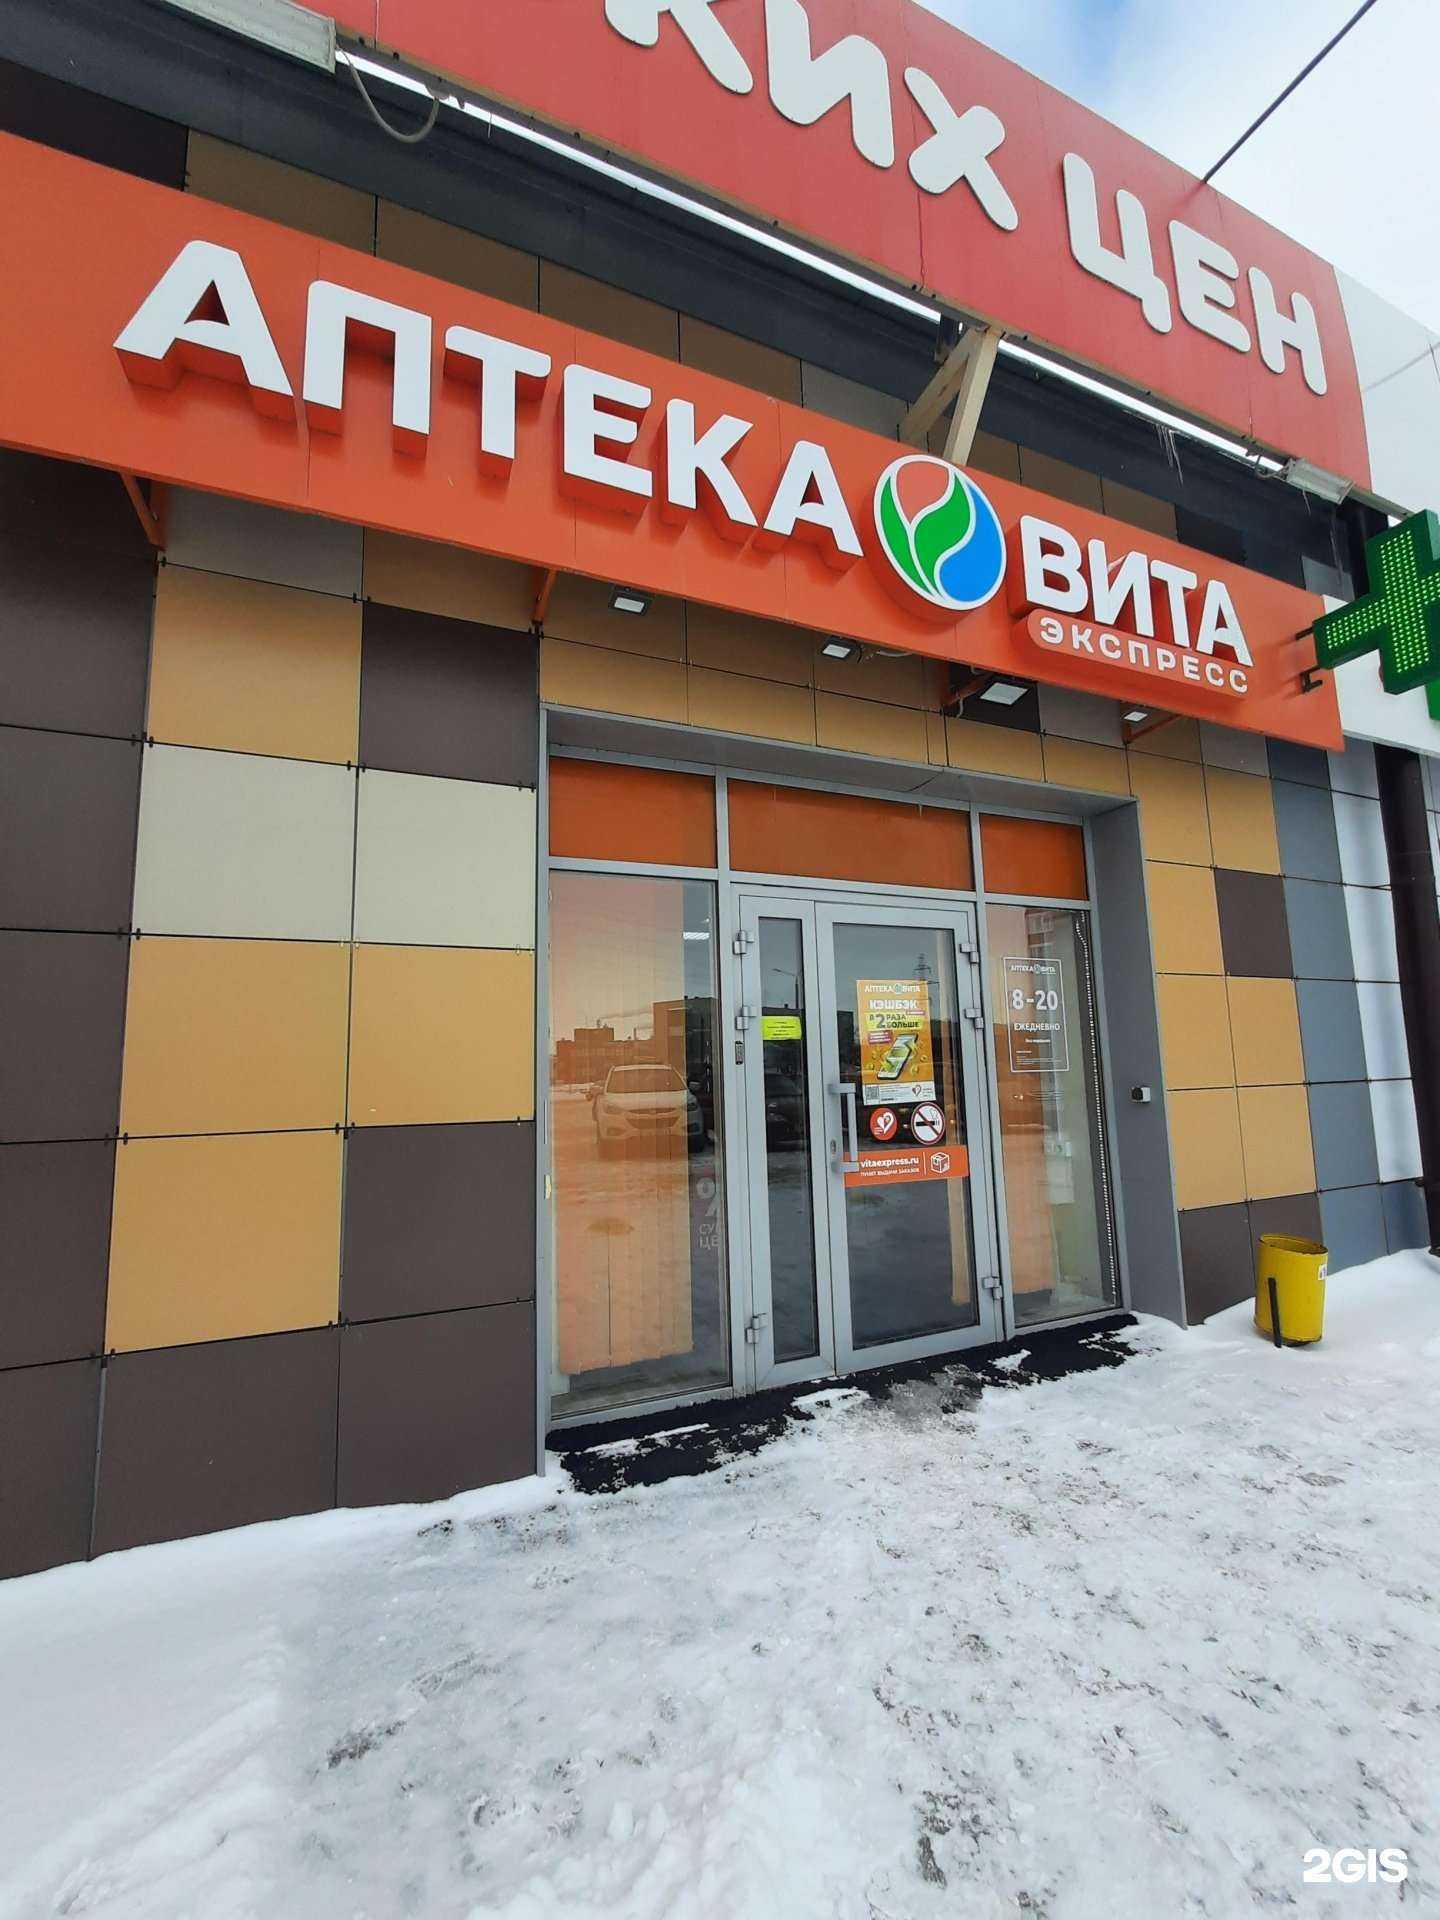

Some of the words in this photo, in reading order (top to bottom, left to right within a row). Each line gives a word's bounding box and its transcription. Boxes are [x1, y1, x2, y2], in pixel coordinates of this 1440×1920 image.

[1062, 152, 1326, 396] ЦЕН
[113, 239, 863, 558] АПТЕКА
[1020, 515, 1254, 667] ВИТА
[1039, 616, 1248, 694] ЭКСПРЕСС
[869, 999, 918, 1010] КЭШБЭК
[876, 1014, 886, 1028] 2
[886, 1013, 906, 1021] РАЗА
[886, 1021, 920, 1029] БОЛЬШЕ
[1014, 1022, 1060, 1032] ЕЖЕДНЕВНО
[860, 1156, 919, 1168] vitaexpress.ru
